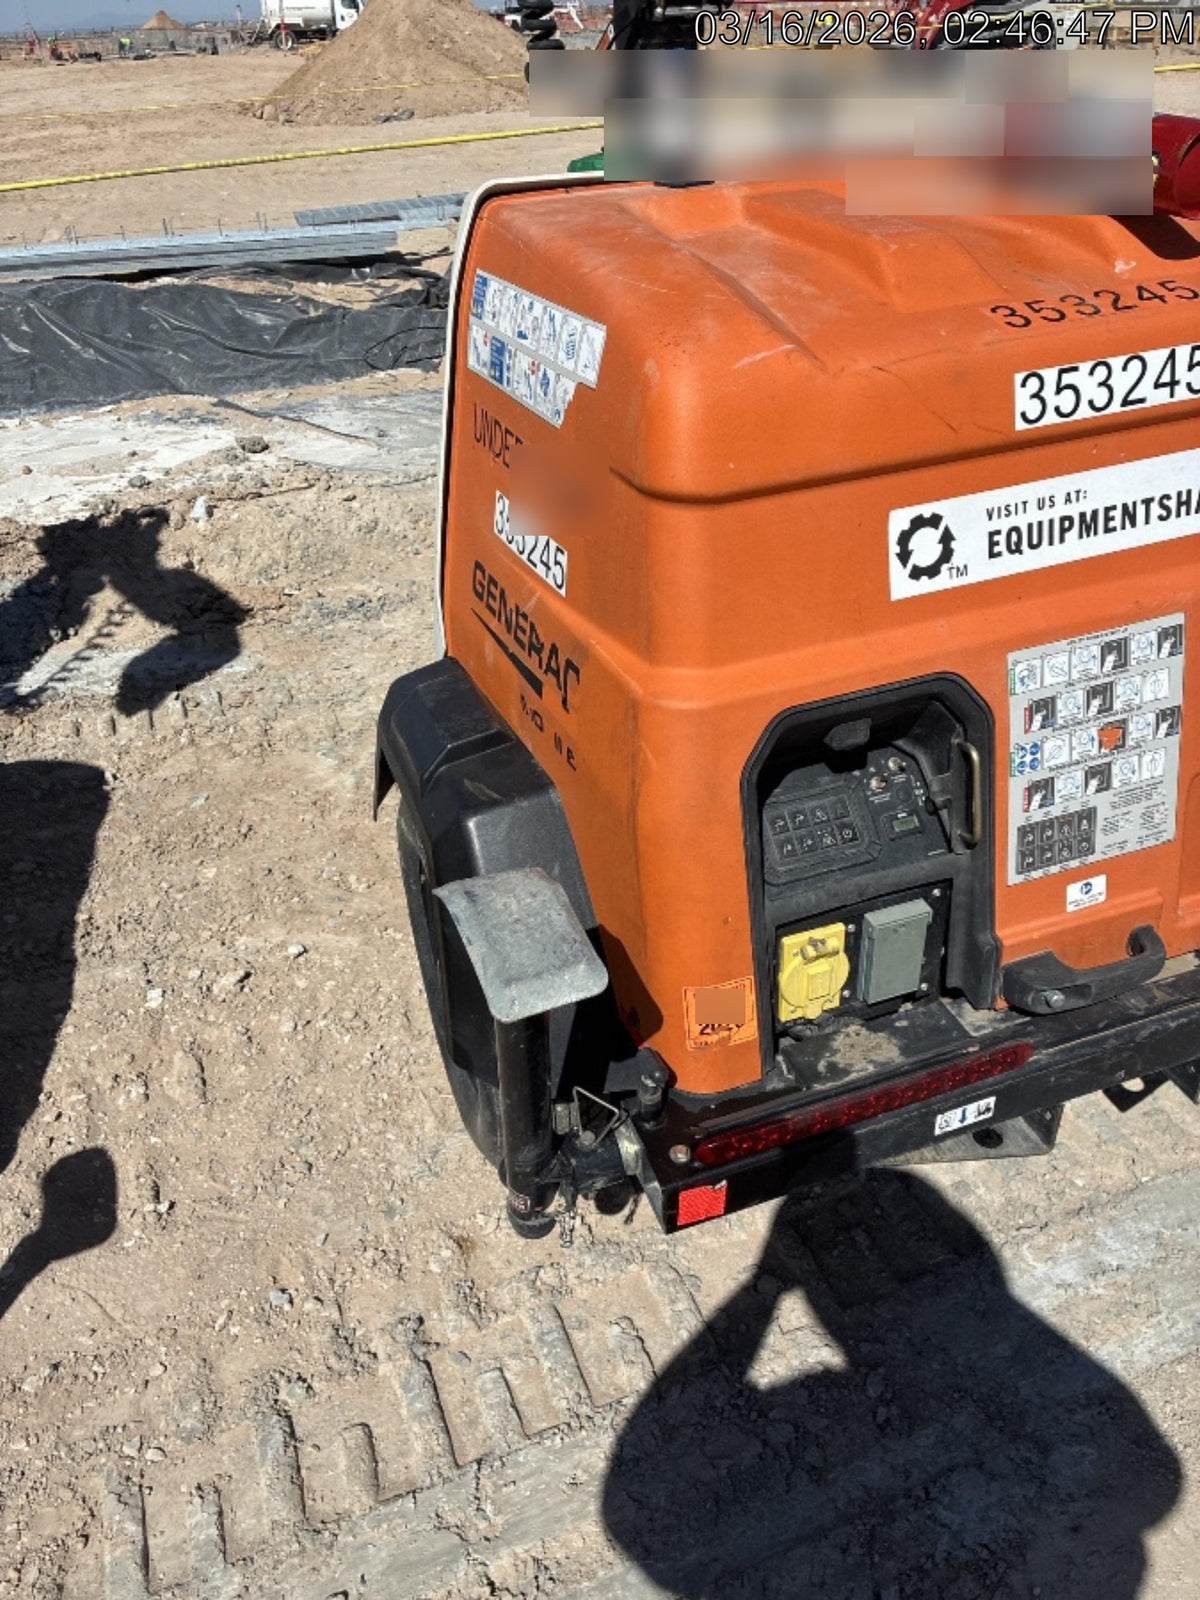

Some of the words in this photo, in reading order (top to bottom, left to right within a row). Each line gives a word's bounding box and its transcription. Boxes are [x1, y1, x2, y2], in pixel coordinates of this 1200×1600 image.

[990, 280, 1200, 329] 353245
[473, 402, 523, 469] UNDE
[986, 500, 1029, 522] VISIT
[1037, 494, 1057, 511] US
[1064, 488, 1088, 506] AT:
[948, 563, 969, 580] TM
